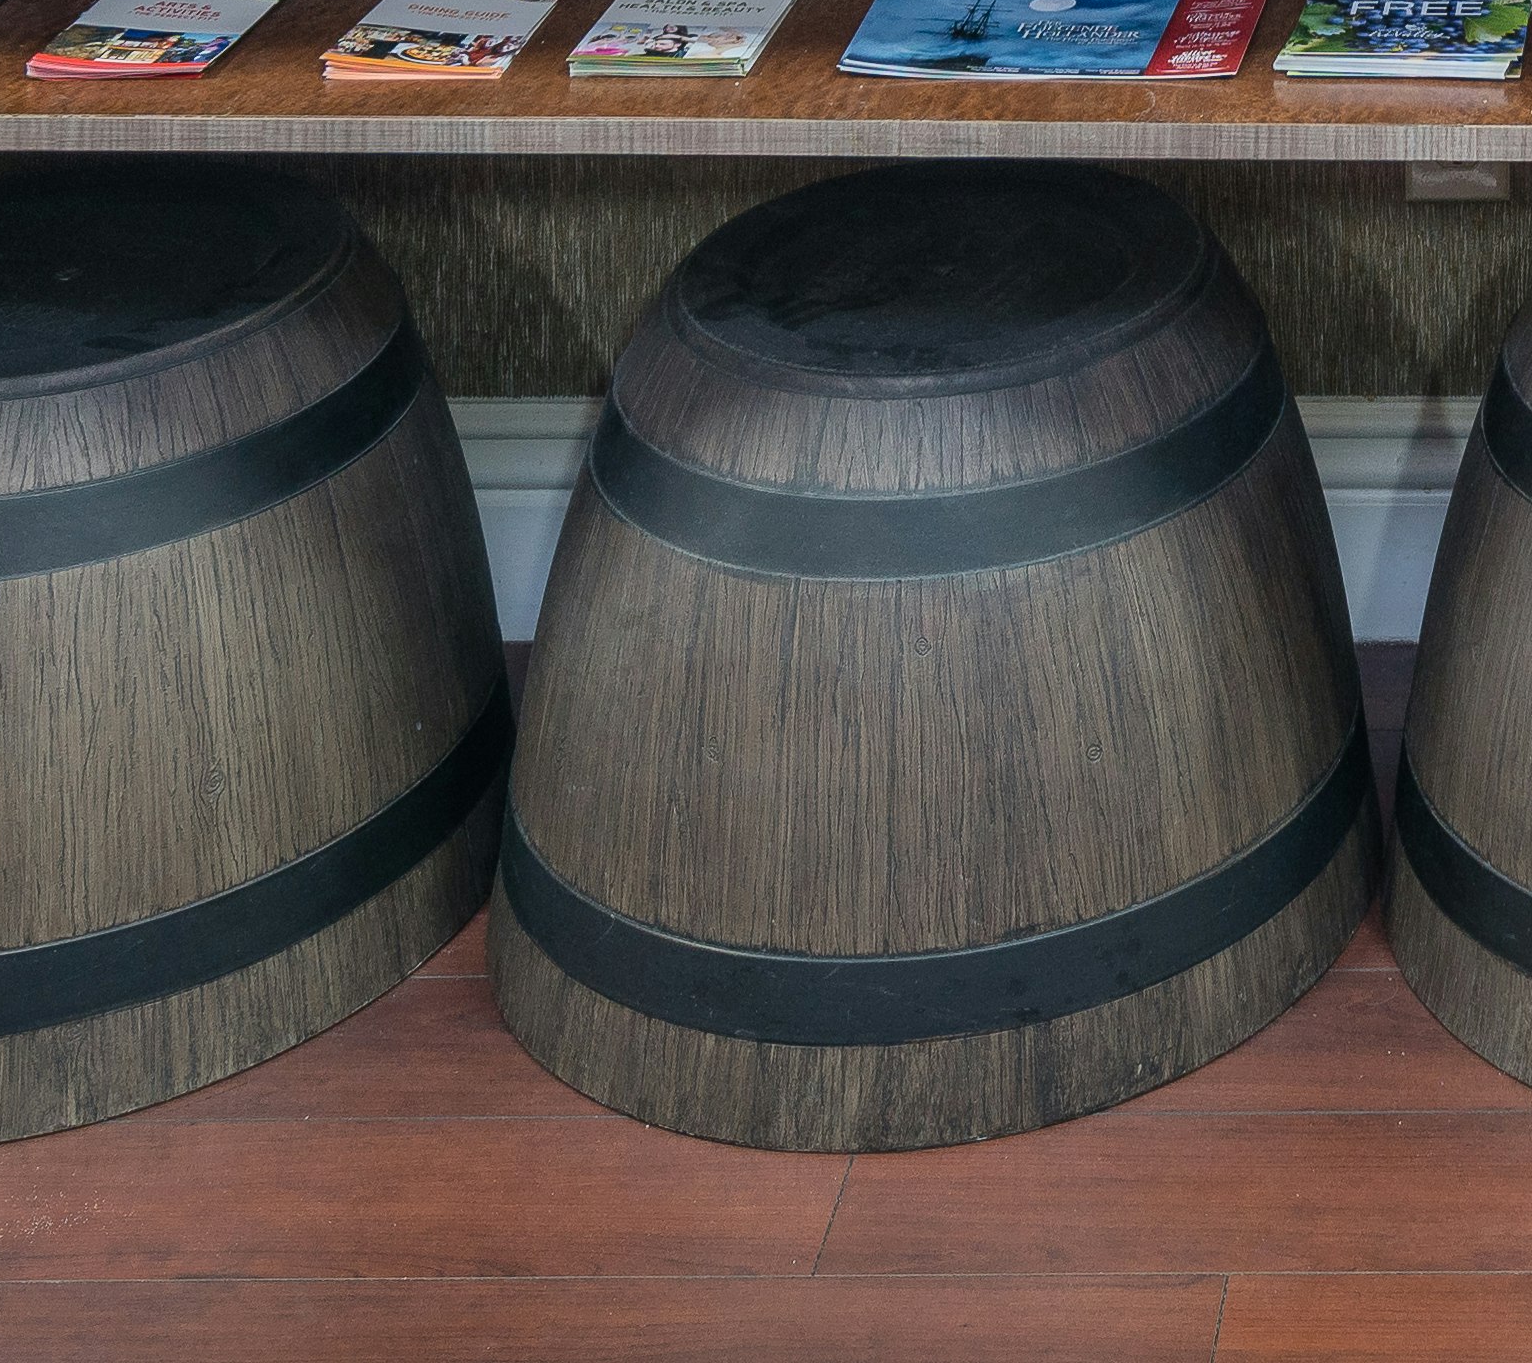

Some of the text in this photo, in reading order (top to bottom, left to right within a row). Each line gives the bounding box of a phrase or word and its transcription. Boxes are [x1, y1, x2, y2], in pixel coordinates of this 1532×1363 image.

[156, 1, 195, 9] ARTS
[619, 3, 686, 12] HEALTH
[1350, 1, 1485, 16] FREE
[134, 5, 221, 17] ACTIVITIES
